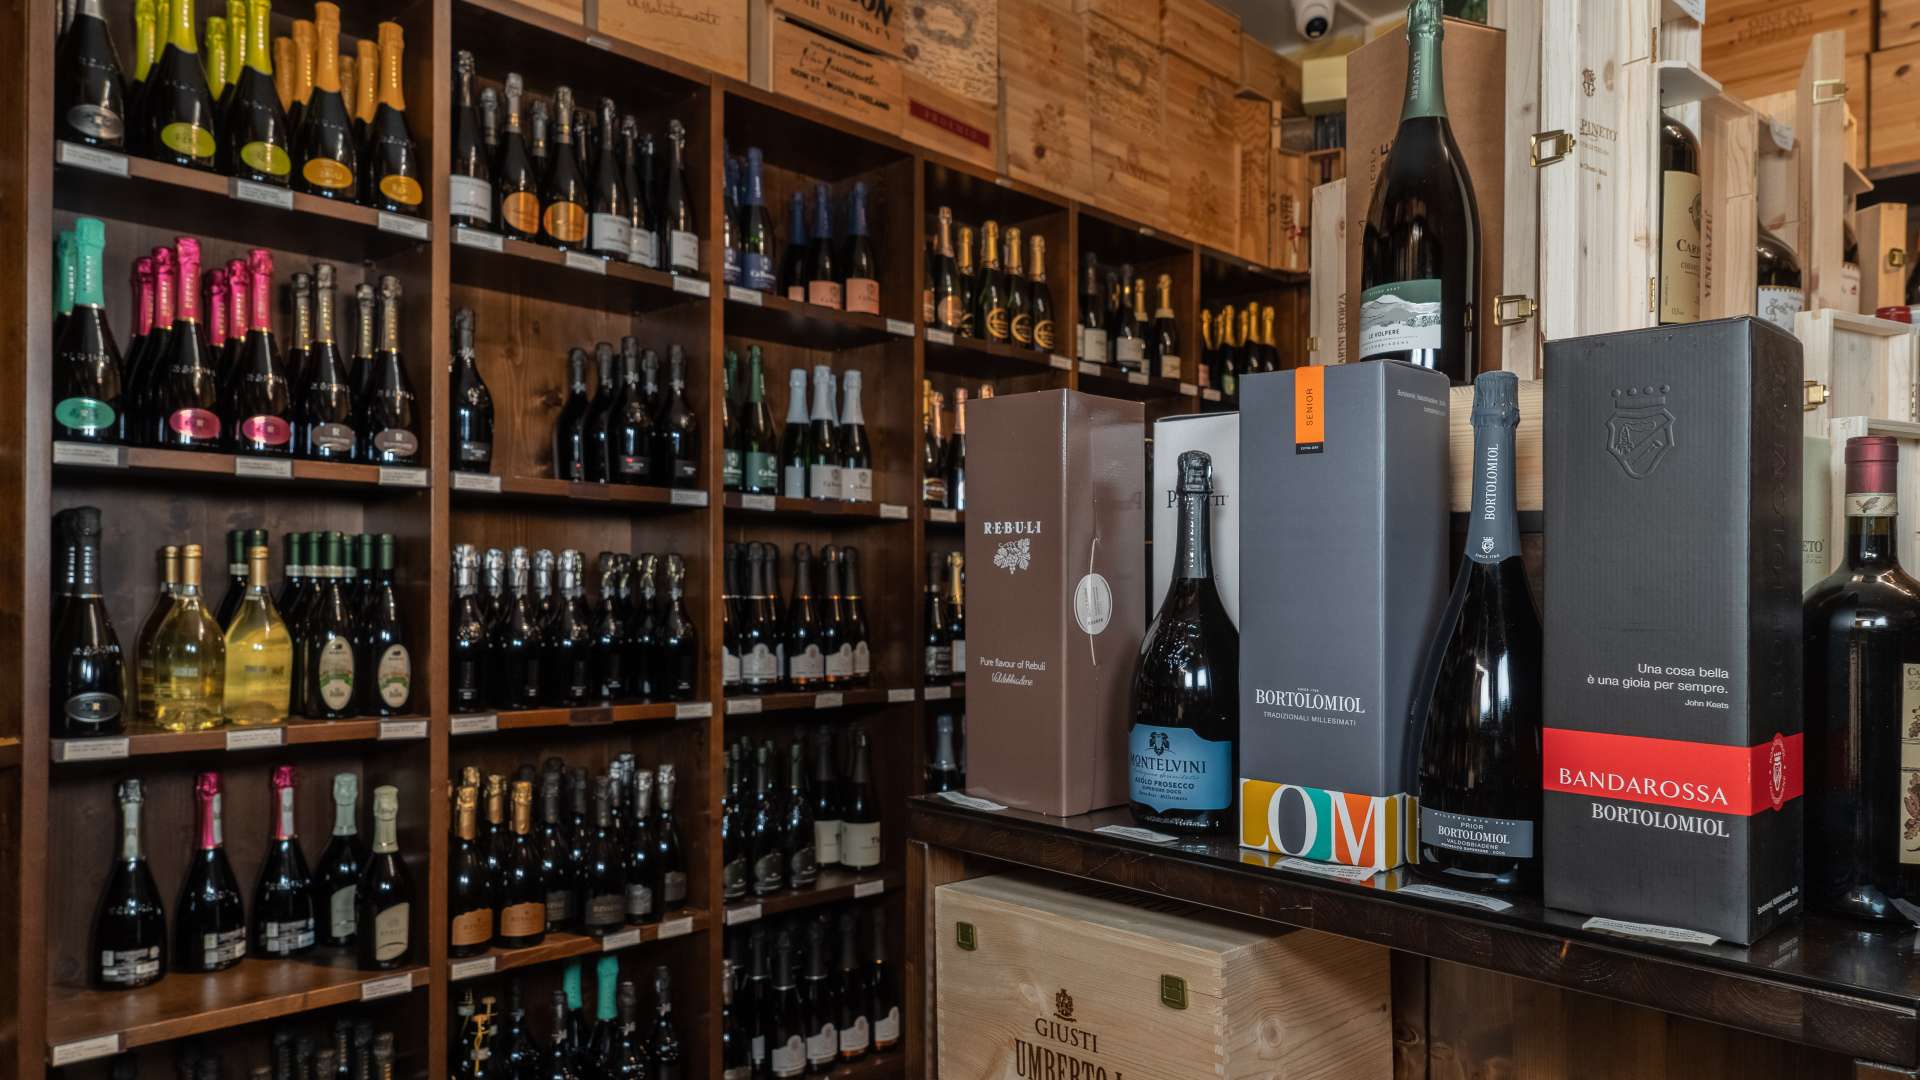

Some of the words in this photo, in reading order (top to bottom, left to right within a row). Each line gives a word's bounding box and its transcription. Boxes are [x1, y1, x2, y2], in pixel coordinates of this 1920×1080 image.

[1579, 119, 1617, 141] PINETO
[1484, 444, 1499, 520] BORTOLOMIOL
[980, 656, 994, 667] Pure
[995, 658, 1015, 669] flavour
[1016, 660, 1024, 669] of
[1025, 660, 1046, 671] Rebuli
[1637, 663, 1662, 674] Una
[1665, 666, 1696, 677] cosa
[1699, 666, 1729, 679] bella
[1587, 674, 1595, 684] è
[1598, 676, 1619, 686] una
[1622, 676, 1650, 689] gioia
[1654, 680, 1674, 692] per
[1678, 682, 1728, 695] sempre.
[1255, 689, 1366, 714] BORTOLOMIOL
[1684, 699, 1704, 708] John
[1706, 700, 1729, 709] Keats
[1263, 711, 1310, 722] TRADIZIONALI
[1311, 716, 1356, 726] MILLESIMATI
[1154, 781, 1195, 790] PROSECCO
[1558, 768, 1728, 806] BANDAROSSA
[1460, 822, 1484, 830] PRIOR
[1591, 803, 1730, 838] BORTOLOMIOL
[1438, 825, 1511, 845] BORTOLOMIOL
[1446, 838, 1499, 850] VALDOBBIADENE
[1034, 1017, 1098, 1053] GIUSTI
